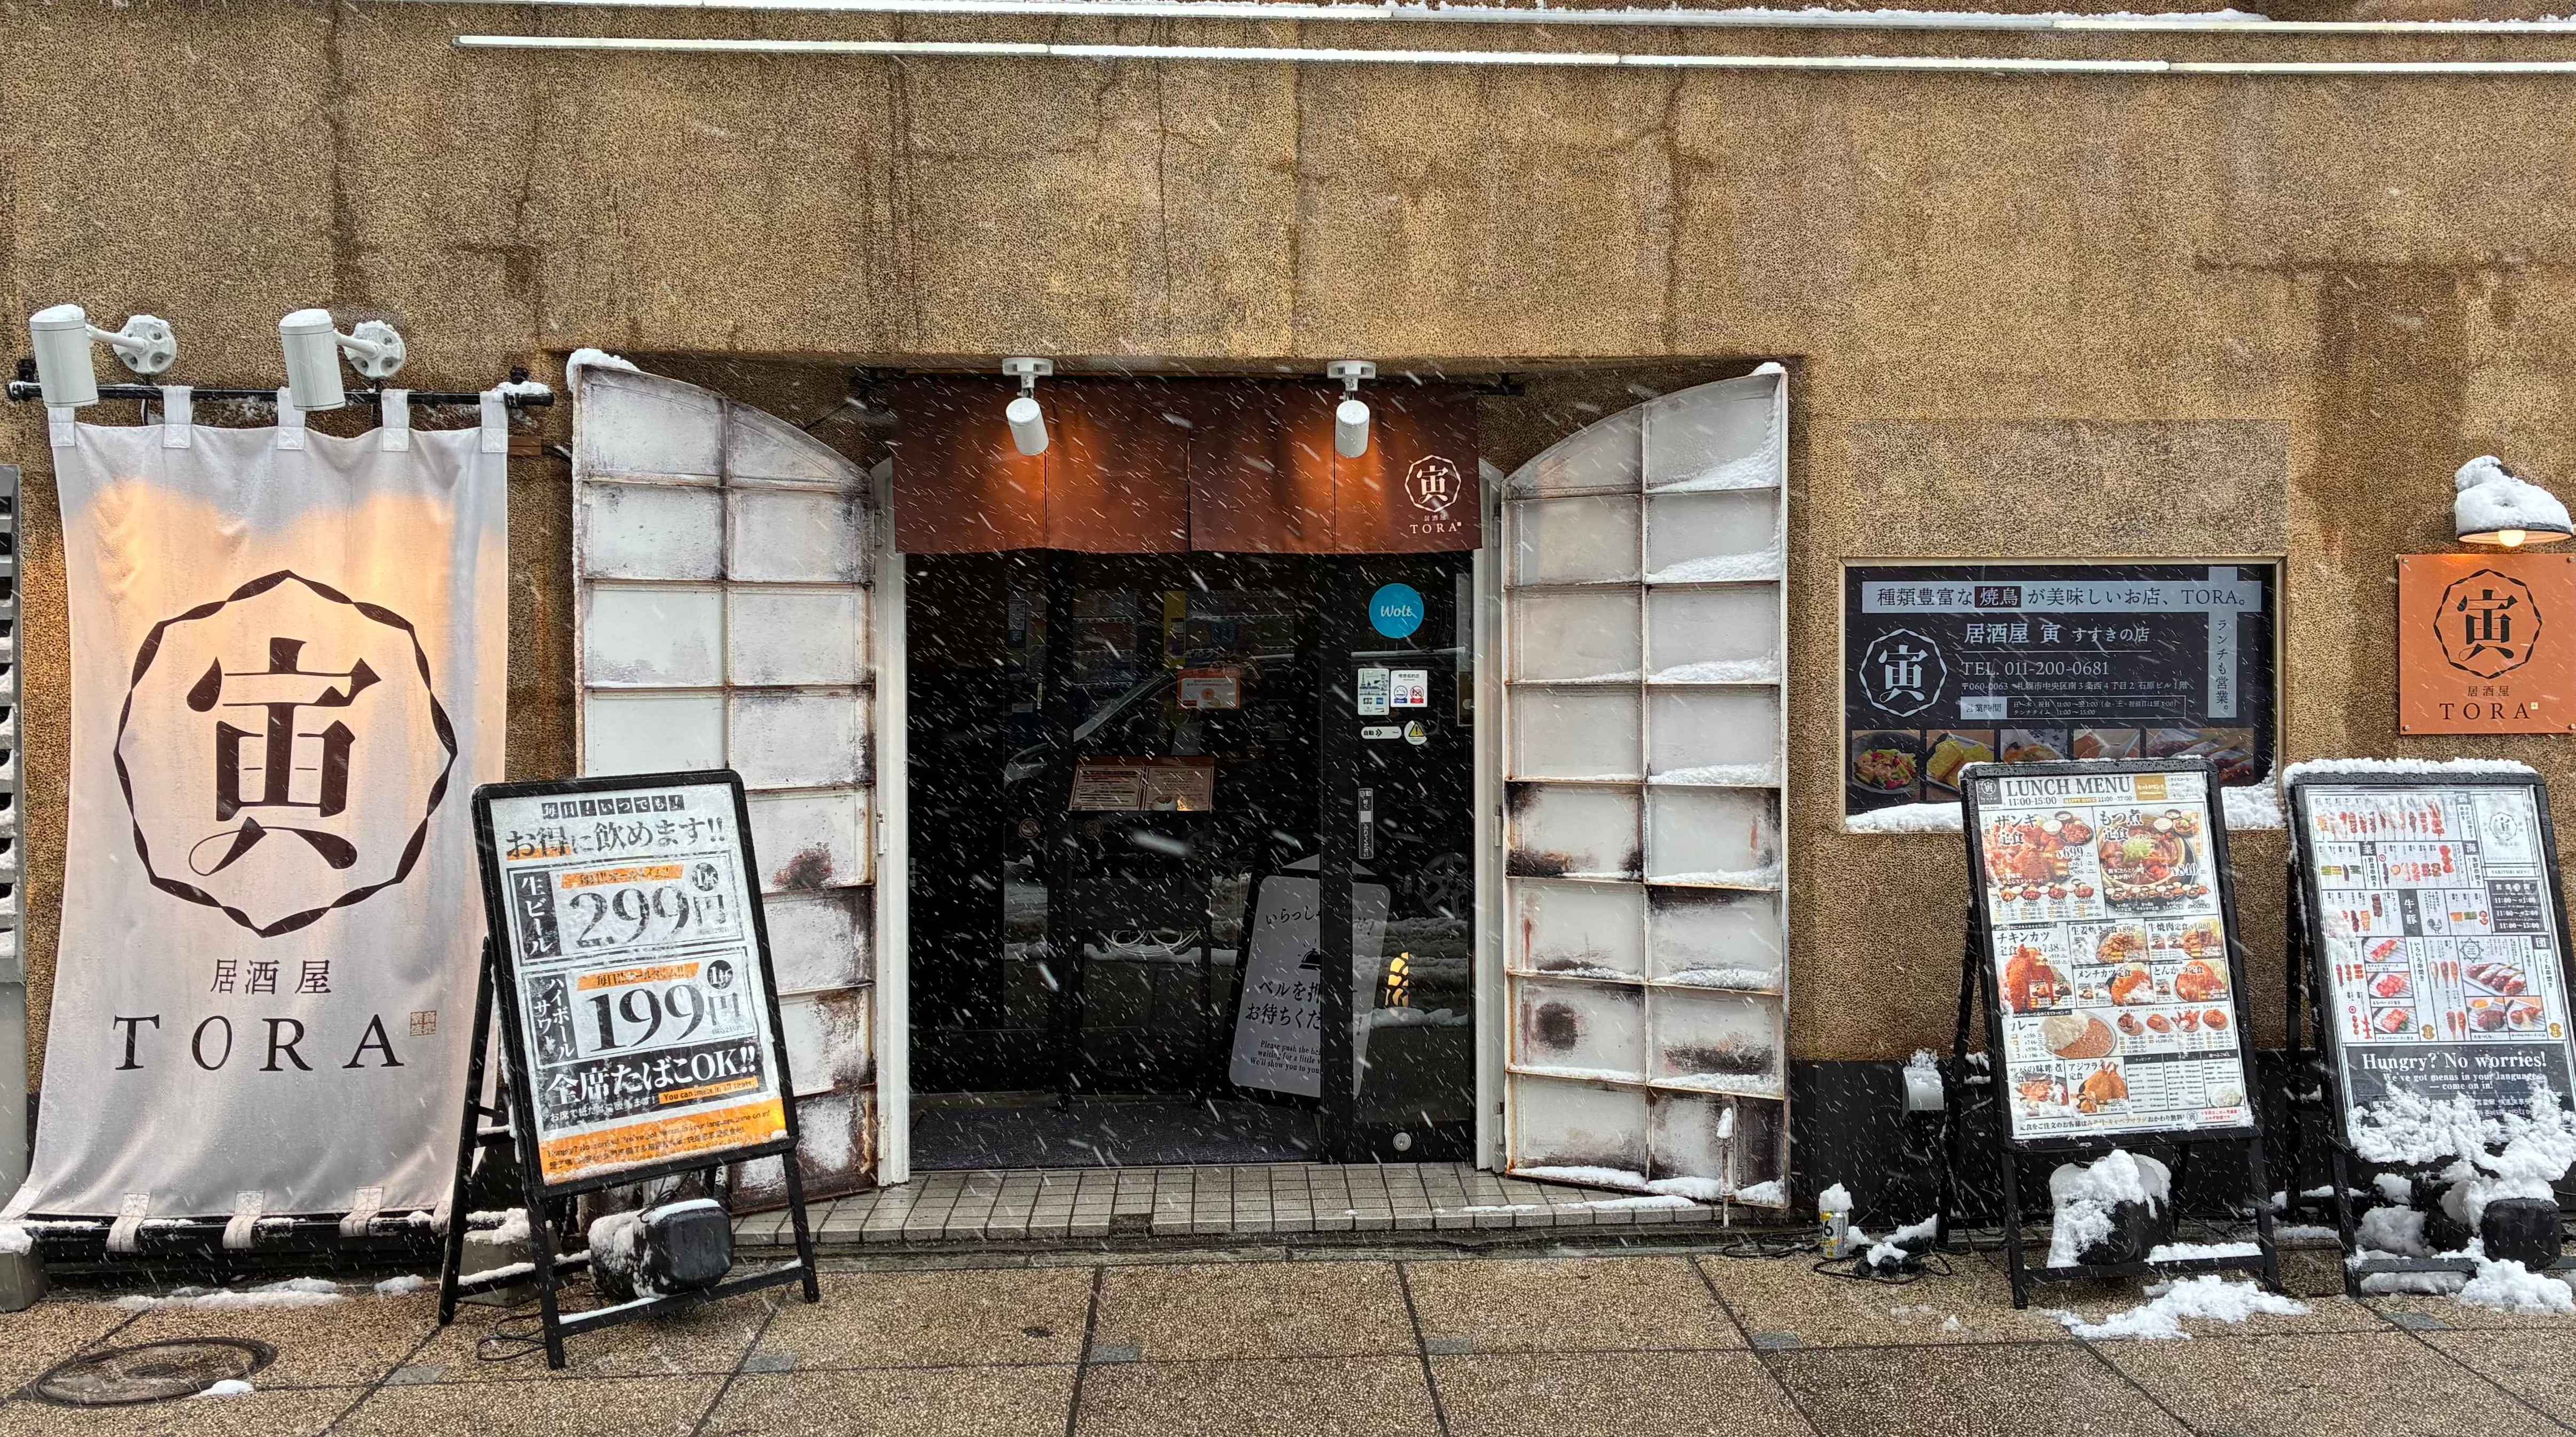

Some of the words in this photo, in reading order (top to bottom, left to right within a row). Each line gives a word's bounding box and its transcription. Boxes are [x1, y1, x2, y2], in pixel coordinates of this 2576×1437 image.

[1410, 522, 1457, 534] TORA
[1381, 605, 1411, 617] Wolt
[2457, 589, 2518, 662] 寅
[1965, 623, 2029, 643] 居酒屋
[2040, 623, 2060, 643] 寅
[2072, 626, 2149, 642] すすきの店
[1878, 645, 1928, 702] 寅
[1961, 661, 1999, 676] TEL.
[2004, 661, 2109, 676] 011-200-0681
[2468, 685, 2510, 697] 居酒屋
[2439, 703, 2530, 720] TORA
[187, 637, 381, 877] 寅
[2005, 778, 2070, 797] LUNCH
[2081, 776, 2132, 794] MENU
[2008, 796, 2057, 806] 11:00-15:00
[1995, 814, 2038, 828] ザンギ
[521, 876, 552, 955] 生ビール
[1997, 932, 2050, 944] チキンカツ
[210, 959, 331, 996] 居酒屋
[549, 979, 575, 1060] ハイボール
[113, 1014, 404, 1072] TORA
[1261, 1040, 1280, 1050] Please
[1299, 1045, 1309, 1054] the
[1267, 1060, 1283, 1068] show
[1283, 1052, 1292, 1061] for
[1300, 1055, 1315, 1064] little
[2362, 1052, 2436, 1071] Hungry?
[2445, 1052, 2469, 1069] No
[2474, 1051, 2547, 1068] worries!
[2414, 1074, 2427, 1083] got
[2431, 1073, 2458, 1081] menus
[2462, 1072, 2470, 1081] in
[2481, 1081, 2494, 1090] in!
[663, 1093, 678, 1101] You
